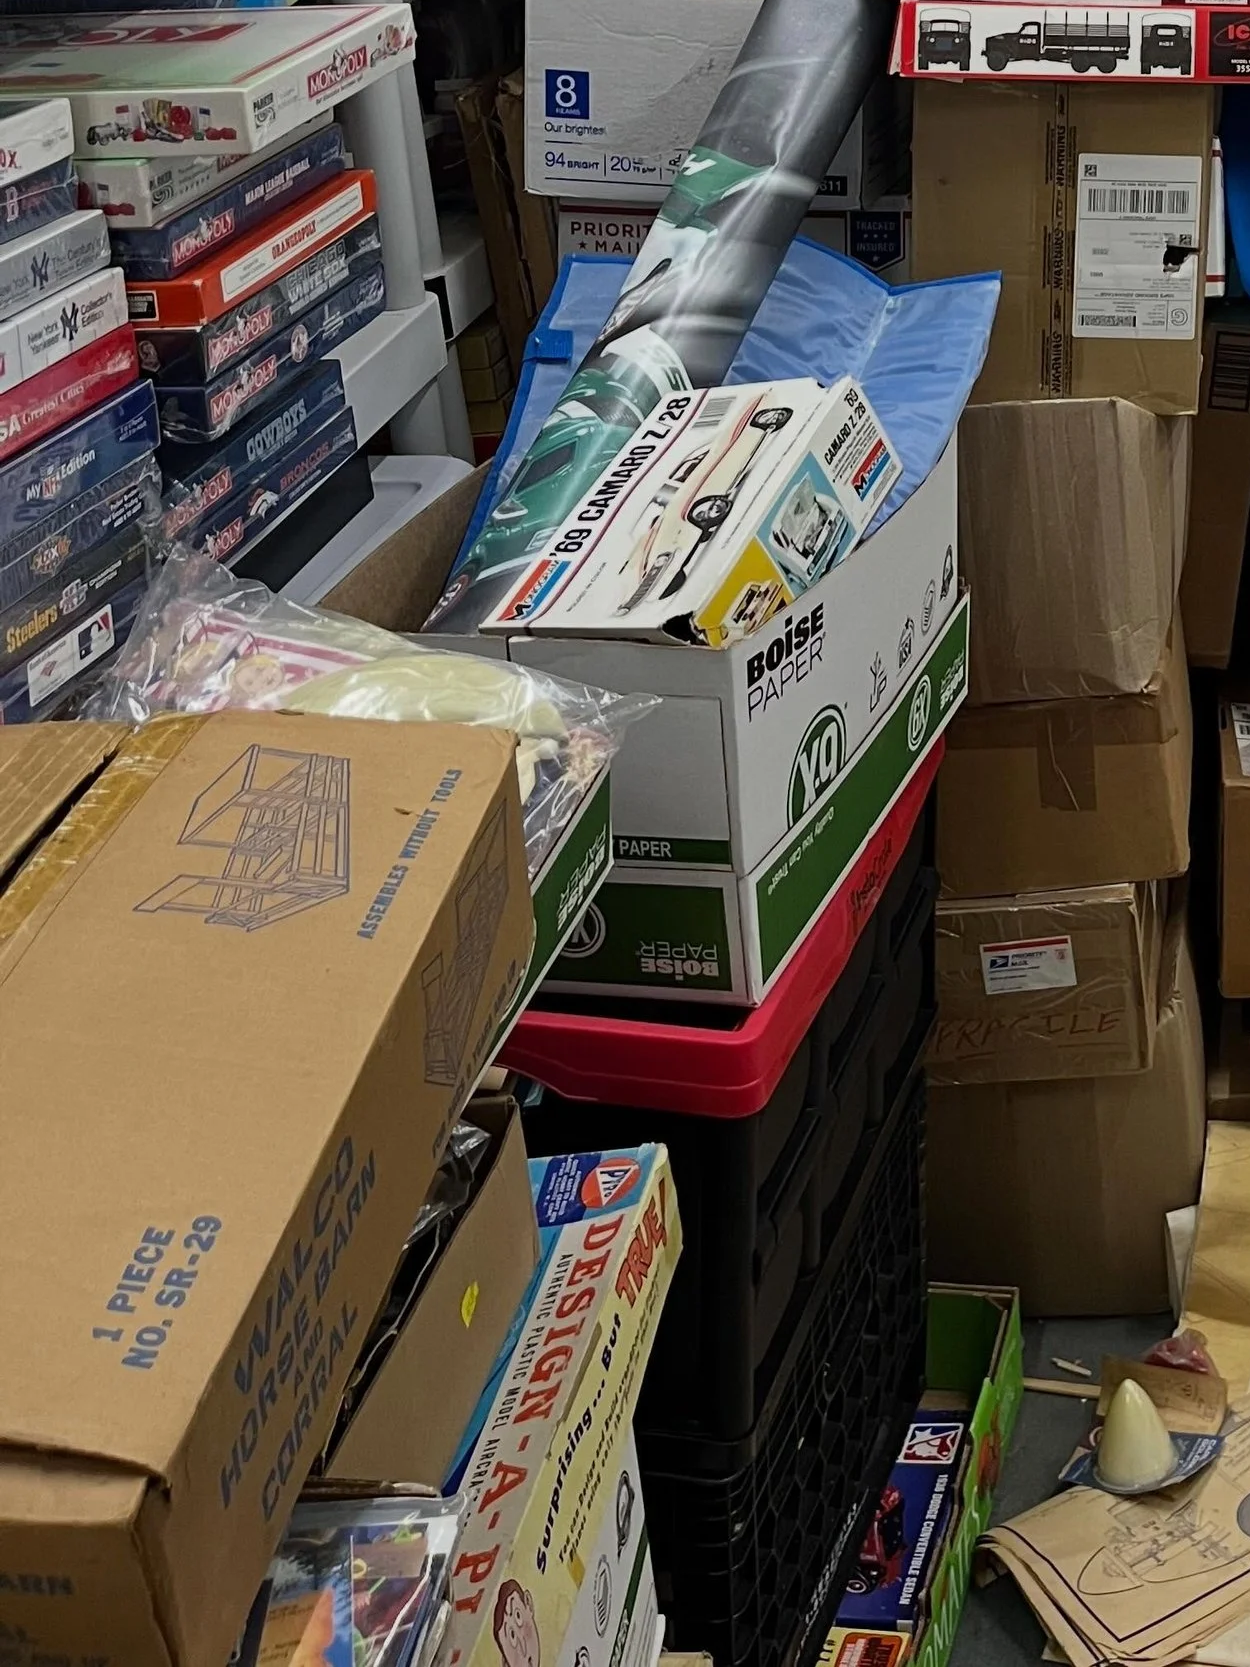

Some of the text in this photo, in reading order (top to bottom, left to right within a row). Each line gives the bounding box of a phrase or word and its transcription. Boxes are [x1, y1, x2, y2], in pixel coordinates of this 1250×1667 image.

[555, 76, 576, 110] 8
[544, 121, 563, 135] Our
[544, 151, 600, 172] 94 BRIGHT
[610, 156, 633, 173] 20
[856, 220, 897, 232] TRACKED
[856, 241, 898, 253] INSURED
[246, 399, 308, 460] COWBOYS
[824, 422, 854, 466] CAMARO
[60, 450, 95, 477] Edition
[279, 441, 330, 490] BRONCOS
[591, 394, 692, 522] CAMARO Z/28
[6, 606, 59, 653] Steelers
[746, 602, 827, 689] BOISE
[748, 633, 825, 723] PAPER
[356, 767, 463, 940] ASSEMBLES WITHOUT TOOLS
[619, 839, 672, 858] PAPER
[635, 941, 717, 961] PAPER
[641, 958, 719, 981] BOISE
[313, 1150, 377, 1302] BARN
[106, 1225, 176, 1314] PIECE
[120, 1215, 224, 1370] NO. SR-29
[536, 1253, 574, 1320] AUTHENTIC
[512, 1326, 544, 1380] PLASTIC
[261, 1300, 360, 1523] CORRAL
[492, 1386, 520, 1431] MODEL
[899, 1493, 943, 1605] DODGE CONVERTIBLE SEDAN
